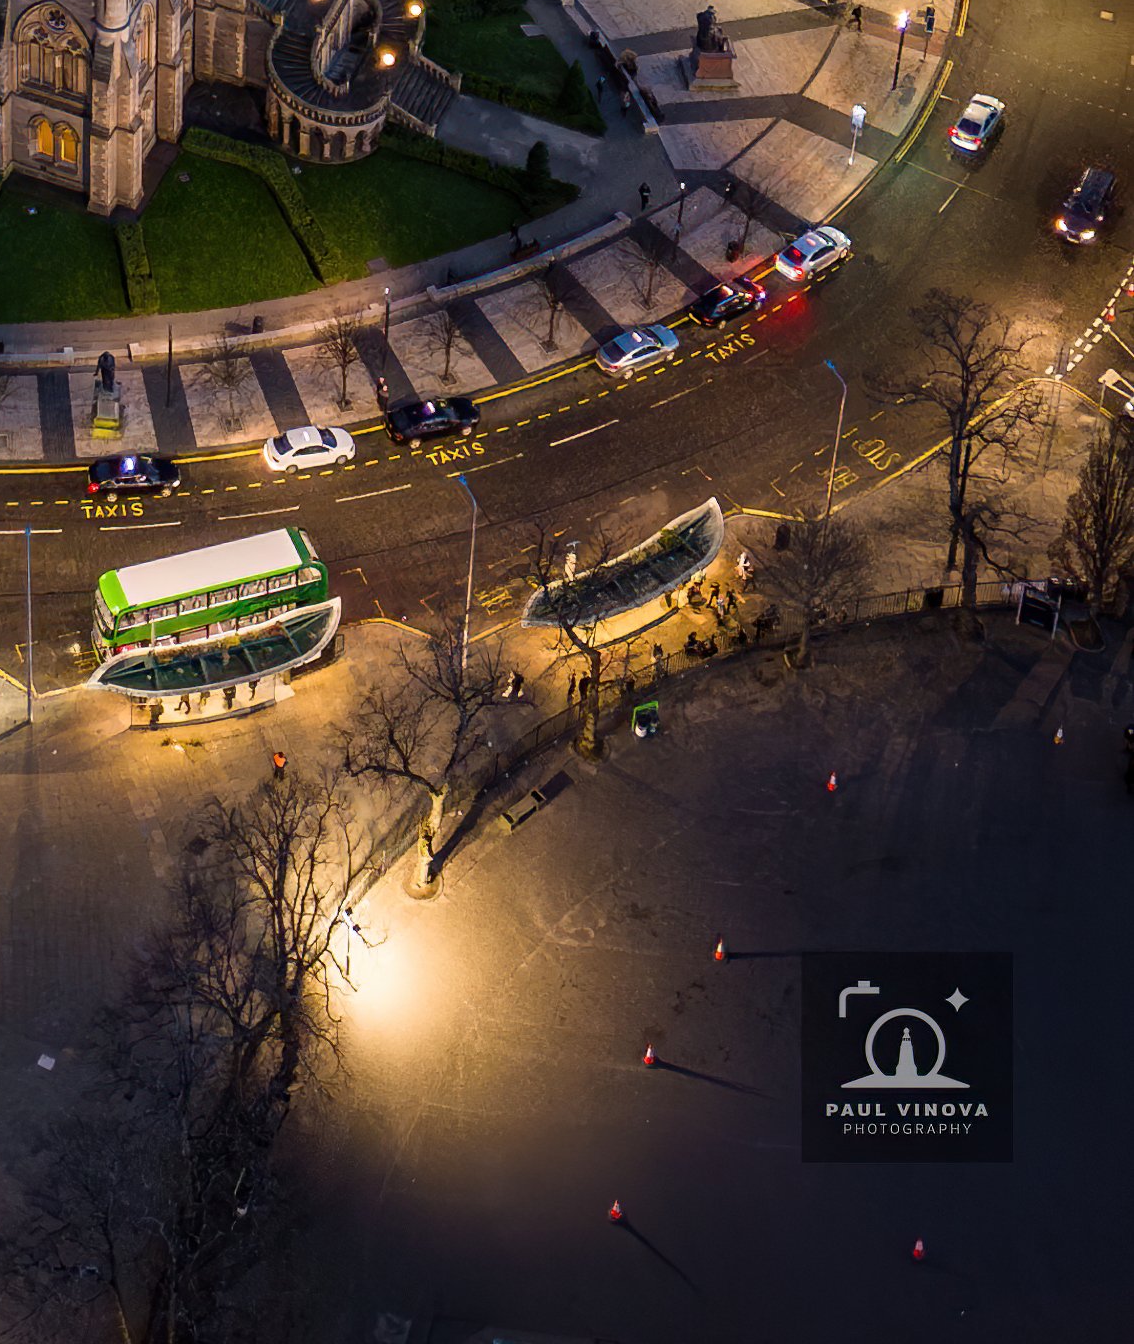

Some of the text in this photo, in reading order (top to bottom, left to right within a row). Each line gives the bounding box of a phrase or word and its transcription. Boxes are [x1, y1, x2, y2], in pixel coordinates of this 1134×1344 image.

[705, 334, 756, 363] TAXIS
[426, 442, 485, 465] TAXIS
[81, 502, 144, 518] TAXIS
